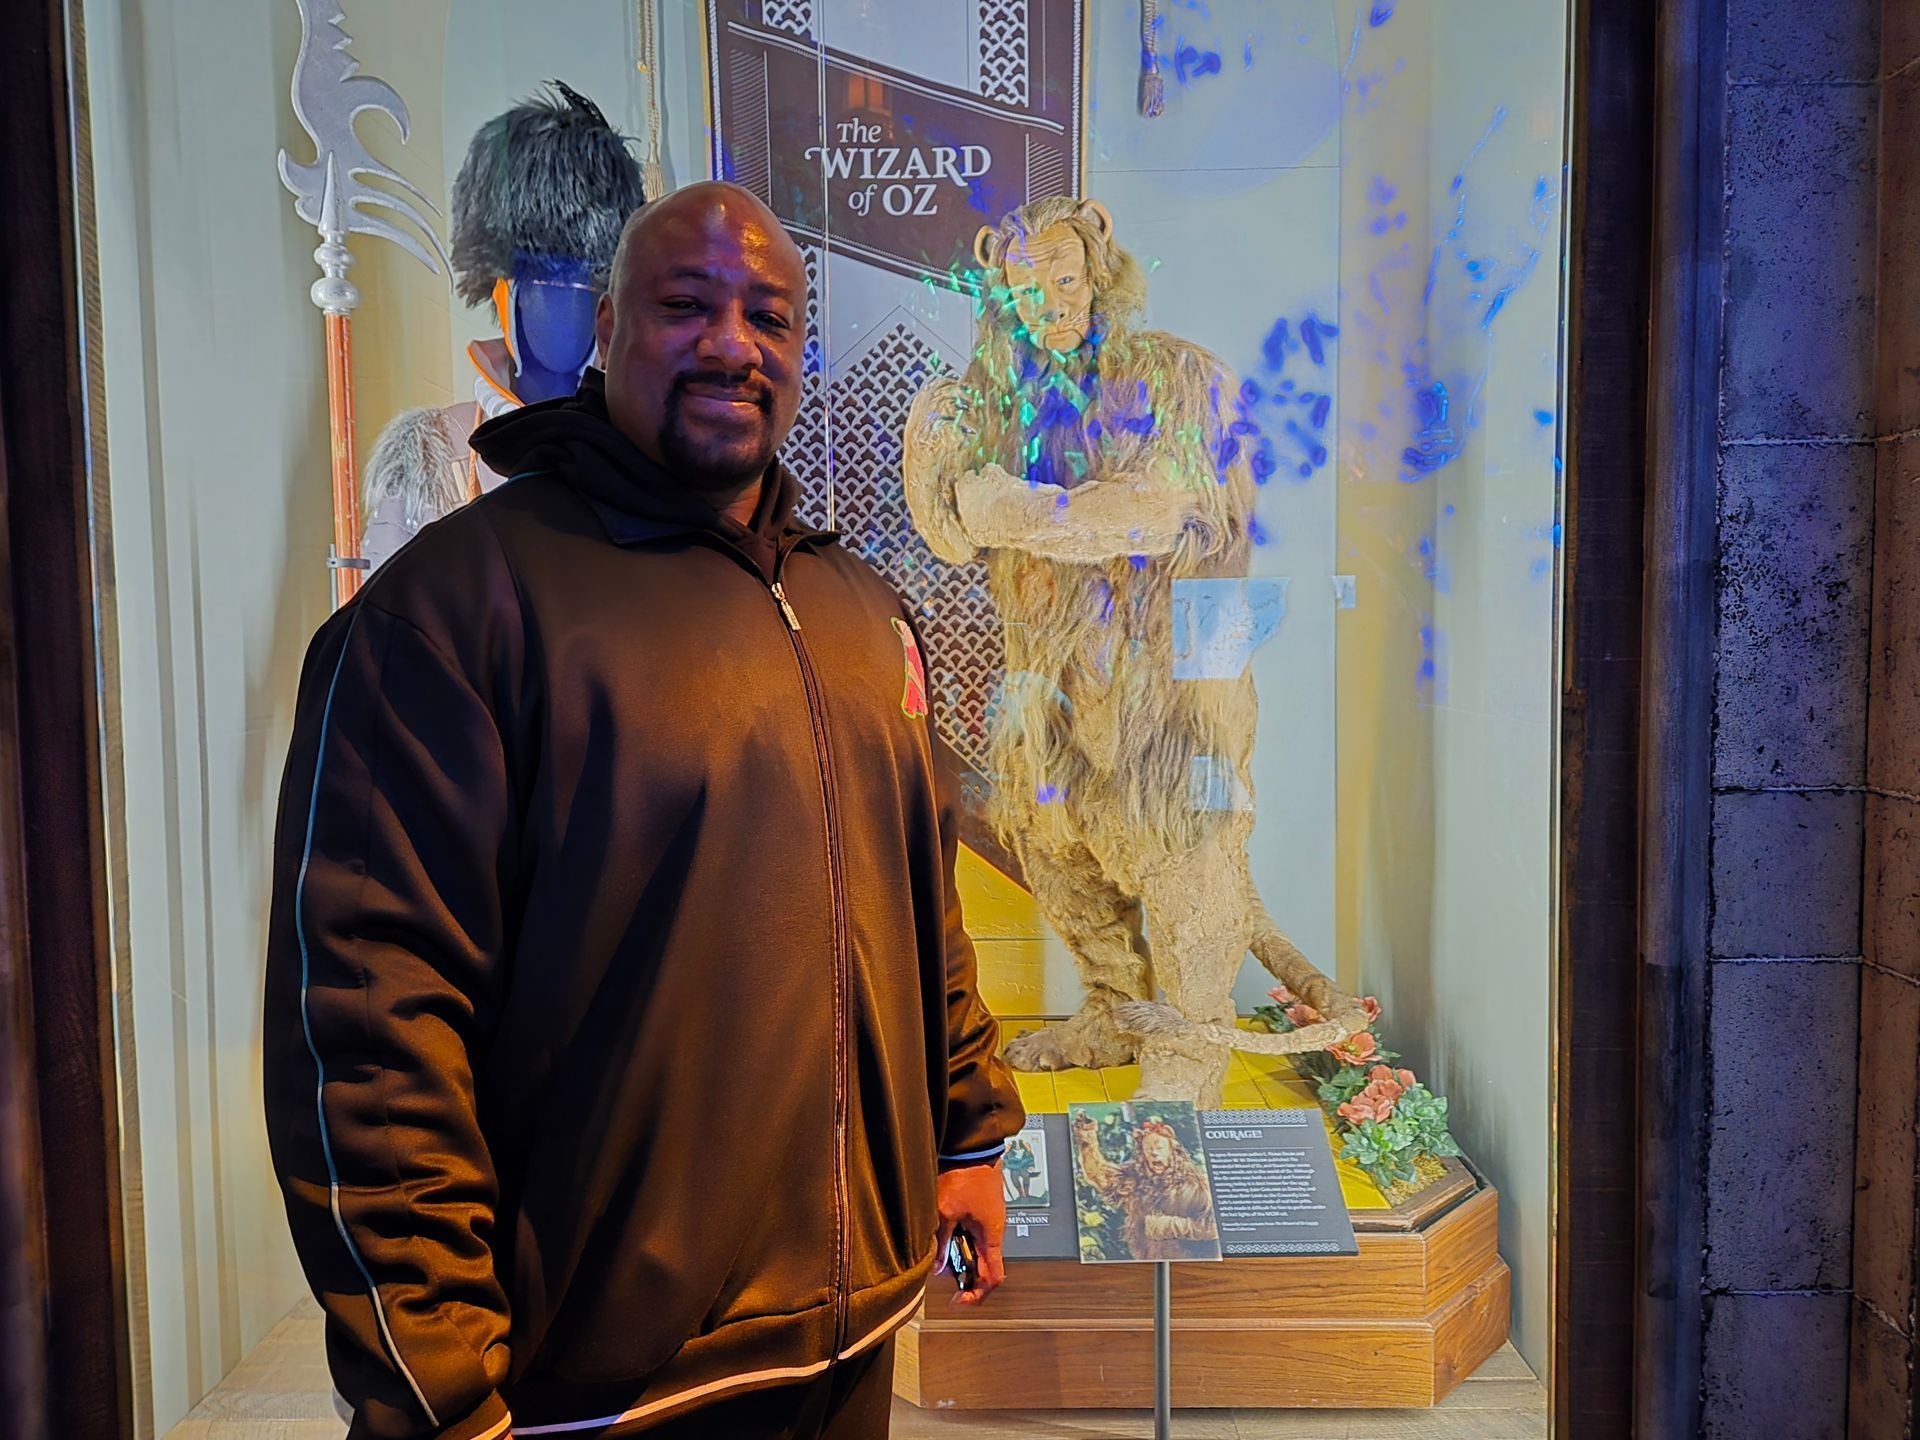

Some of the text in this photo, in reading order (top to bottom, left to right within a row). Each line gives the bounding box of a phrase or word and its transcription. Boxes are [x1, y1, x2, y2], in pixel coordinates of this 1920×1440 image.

[836, 117, 882, 144] The
[804, 145, 992, 188] WIZARD
[848, 183, 938, 217] of OZ
[1205, 1130, 1263, 1141] COURAGE!
